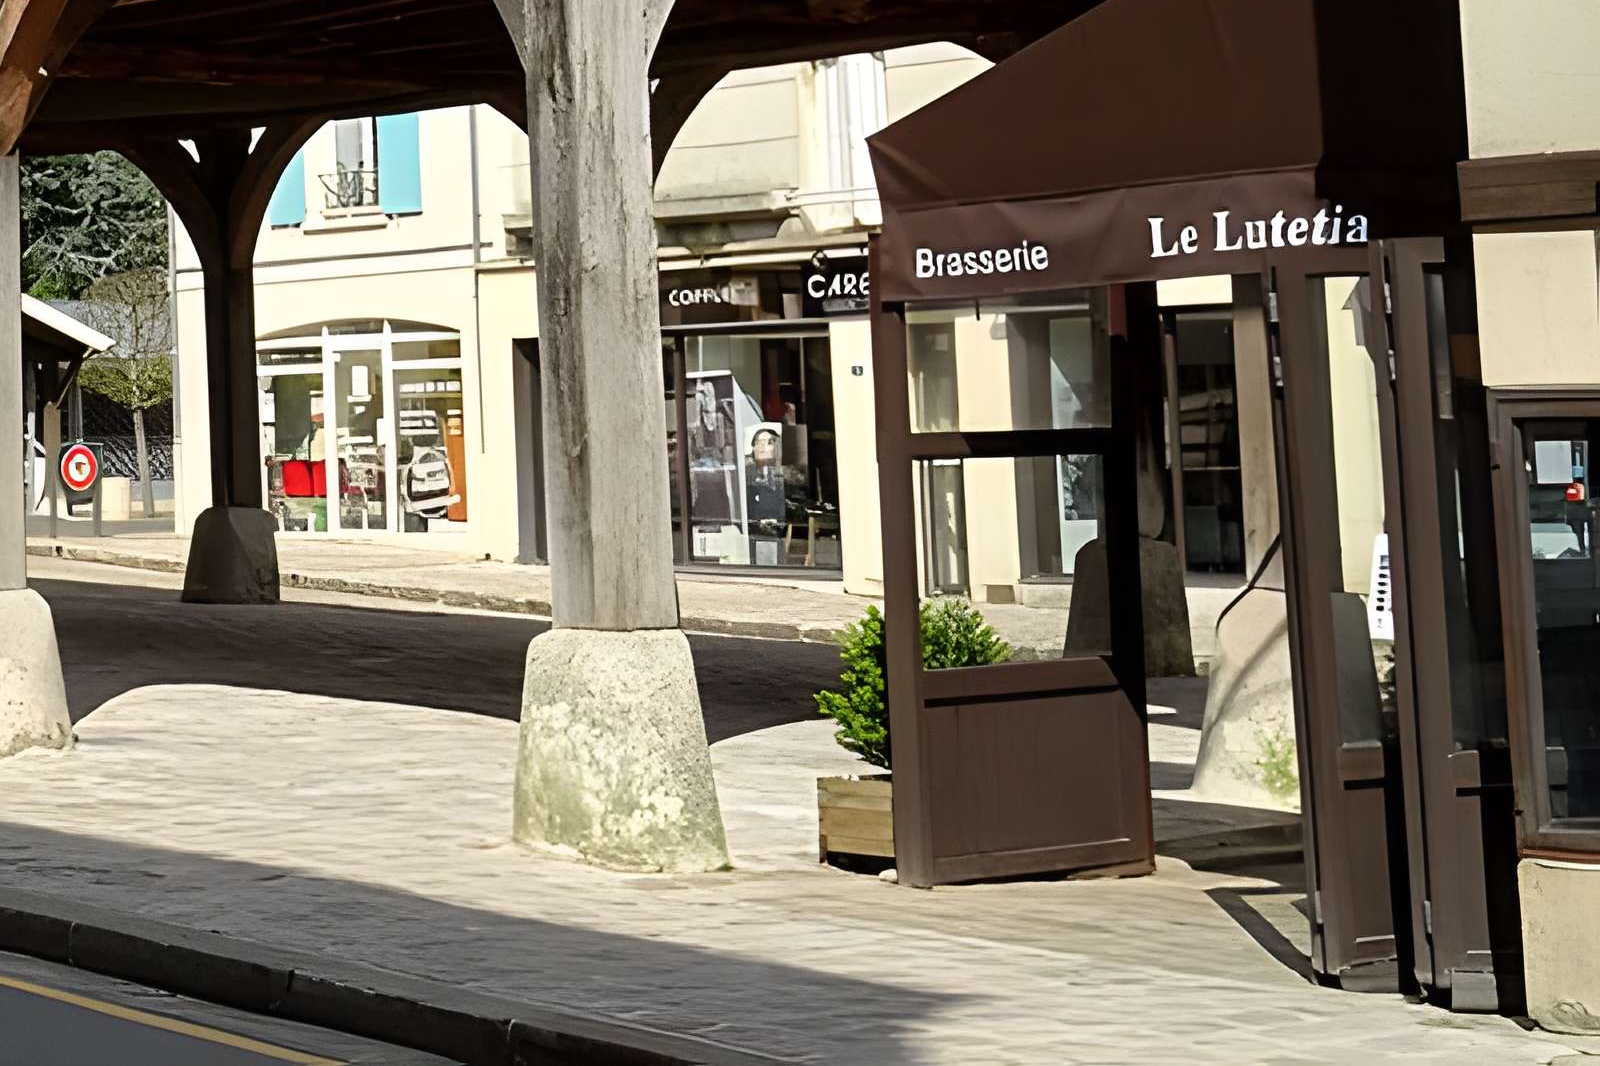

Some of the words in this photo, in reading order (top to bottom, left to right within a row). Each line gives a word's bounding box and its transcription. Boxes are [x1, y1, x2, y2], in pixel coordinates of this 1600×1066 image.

[1148, 216, 1199, 258] Le
[1212, 204, 1369, 252] Lutetia
[915, 240, 1049, 279] Brasserie
